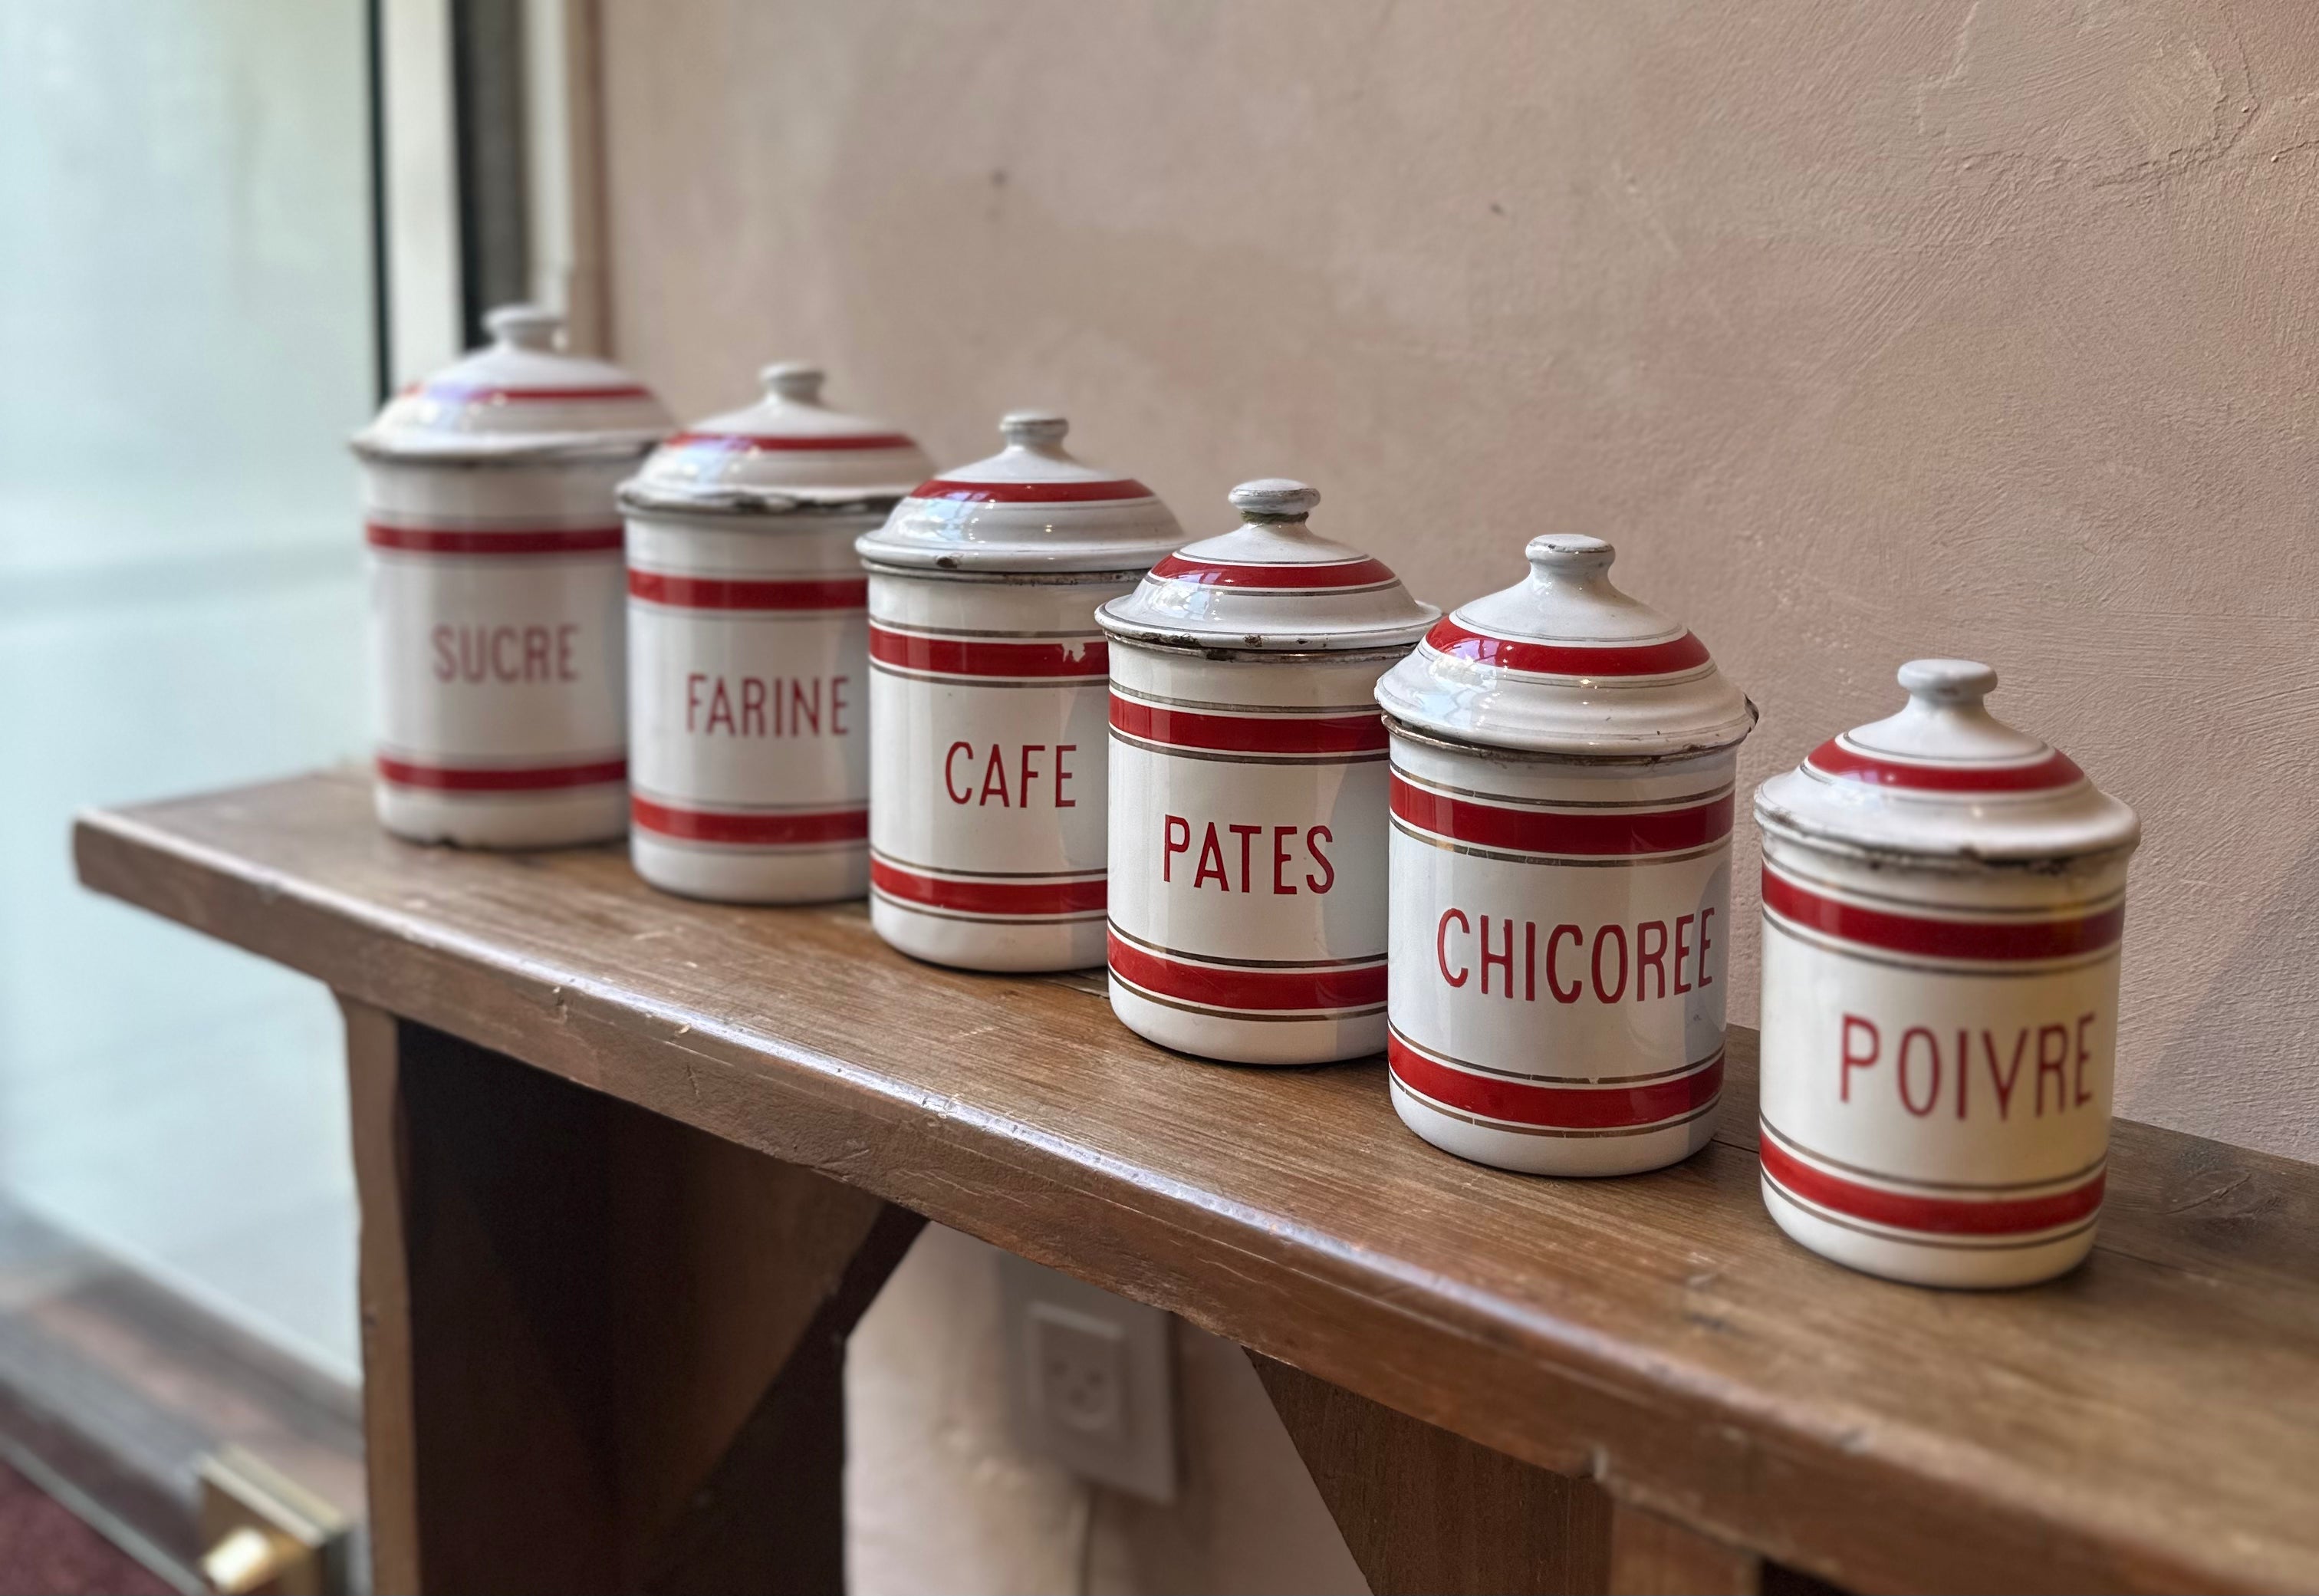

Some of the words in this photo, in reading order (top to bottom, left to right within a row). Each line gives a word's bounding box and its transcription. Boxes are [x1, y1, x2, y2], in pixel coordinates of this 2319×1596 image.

[432, 624, 581, 686] SUCRE
[686, 673, 850, 739] FARINE
[945, 741, 1076, 808] CAFE
[1163, 814, 1334, 895] PATES
[1437, 907, 1715, 1005] CHICOREE
[1840, 1011, 2097, 1122] POIVRE
